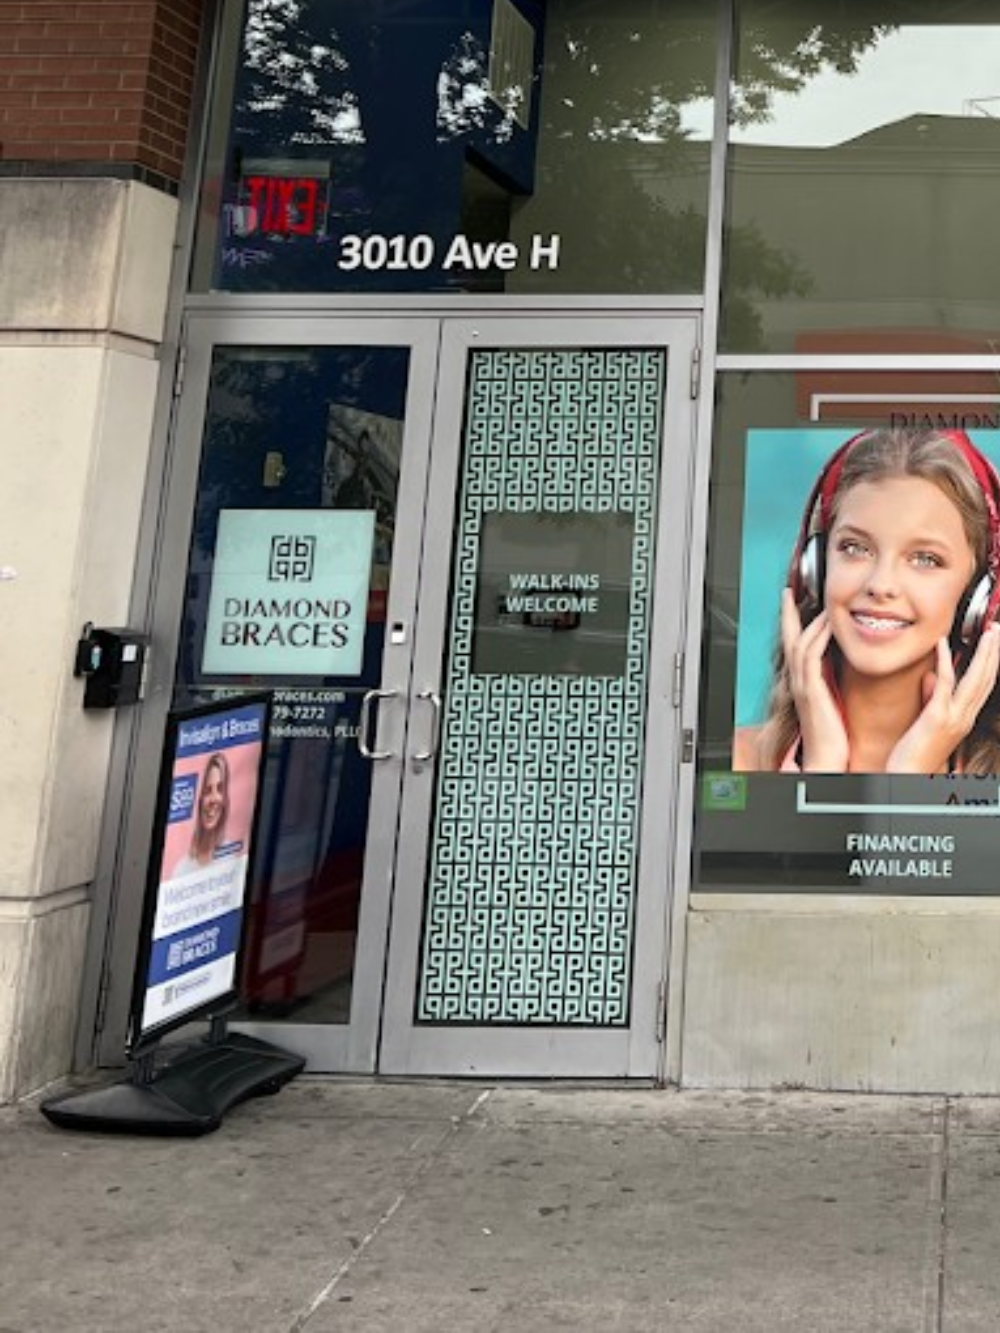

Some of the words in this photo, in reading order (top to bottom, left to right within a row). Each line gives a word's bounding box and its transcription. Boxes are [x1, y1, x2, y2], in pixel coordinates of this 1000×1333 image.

[338, 234, 435, 270] 3010
[443, 234, 518, 270] Ave
[530, 234, 561, 269] H
[508, 573, 600, 590] WALK-INS
[223, 597, 352, 620] DIAMOND
[505, 597, 599, 613] WELCOME
[219, 621, 350, 649] BRACES
[846, 834, 956, 854] FINANCING
[848, 859, 953, 878] AVAILABLE
